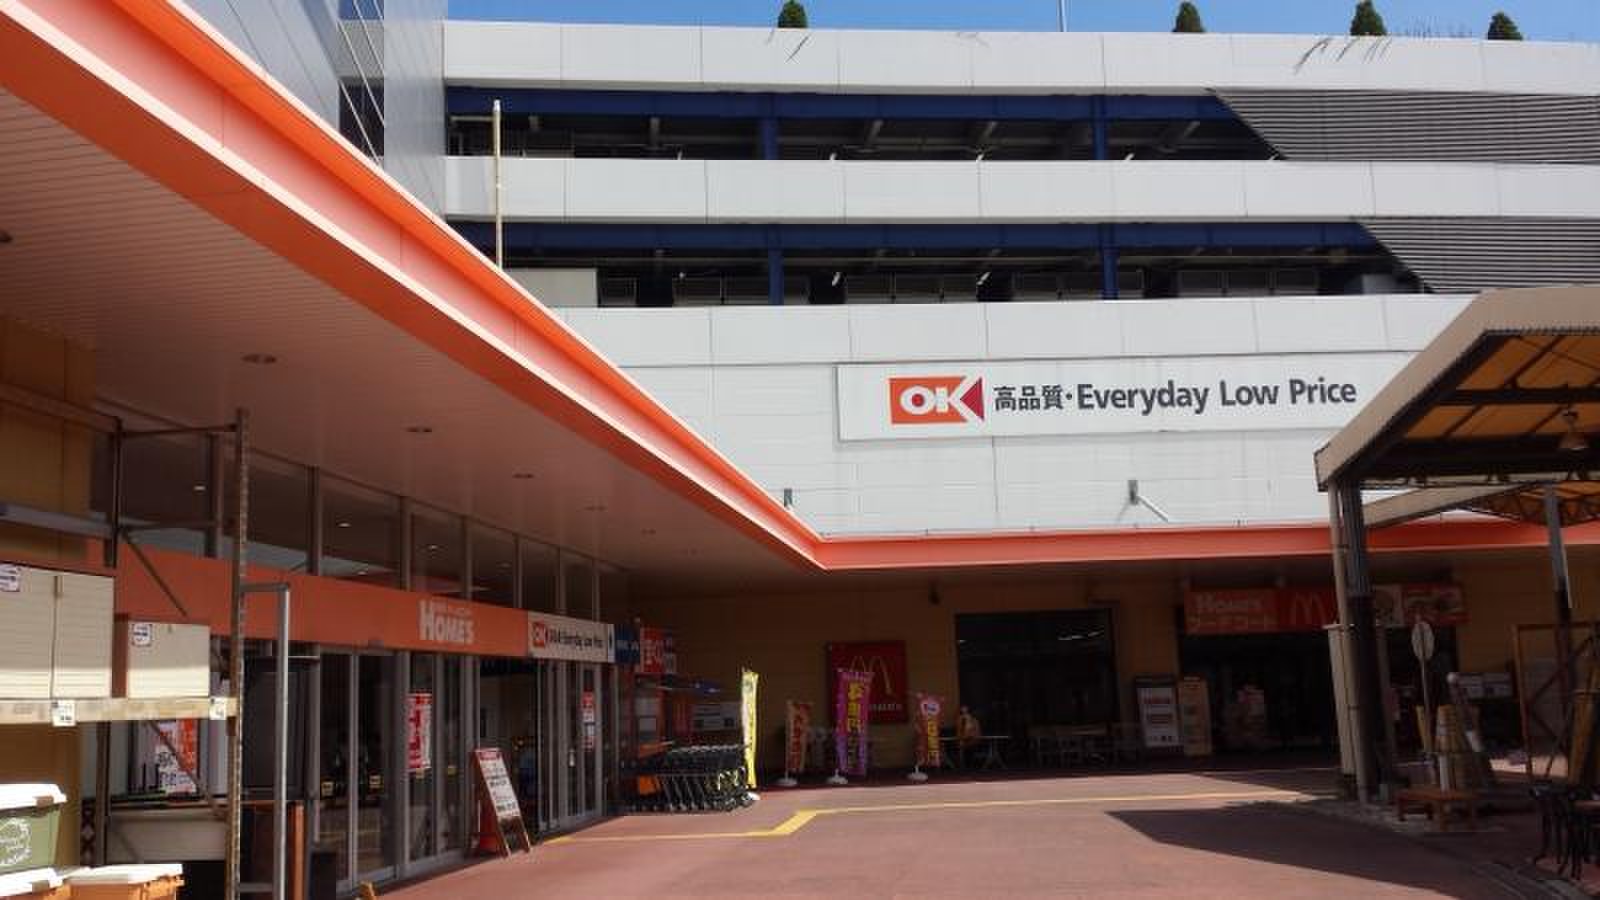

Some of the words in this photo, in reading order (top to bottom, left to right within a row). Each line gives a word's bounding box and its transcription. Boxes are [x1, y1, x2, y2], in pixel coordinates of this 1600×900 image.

[899, 379, 979, 421] OK
[1077, 379, 1209, 415] Everyday
[1219, 379, 1279, 406] Low
[1289, 376, 1357, 404] Price
